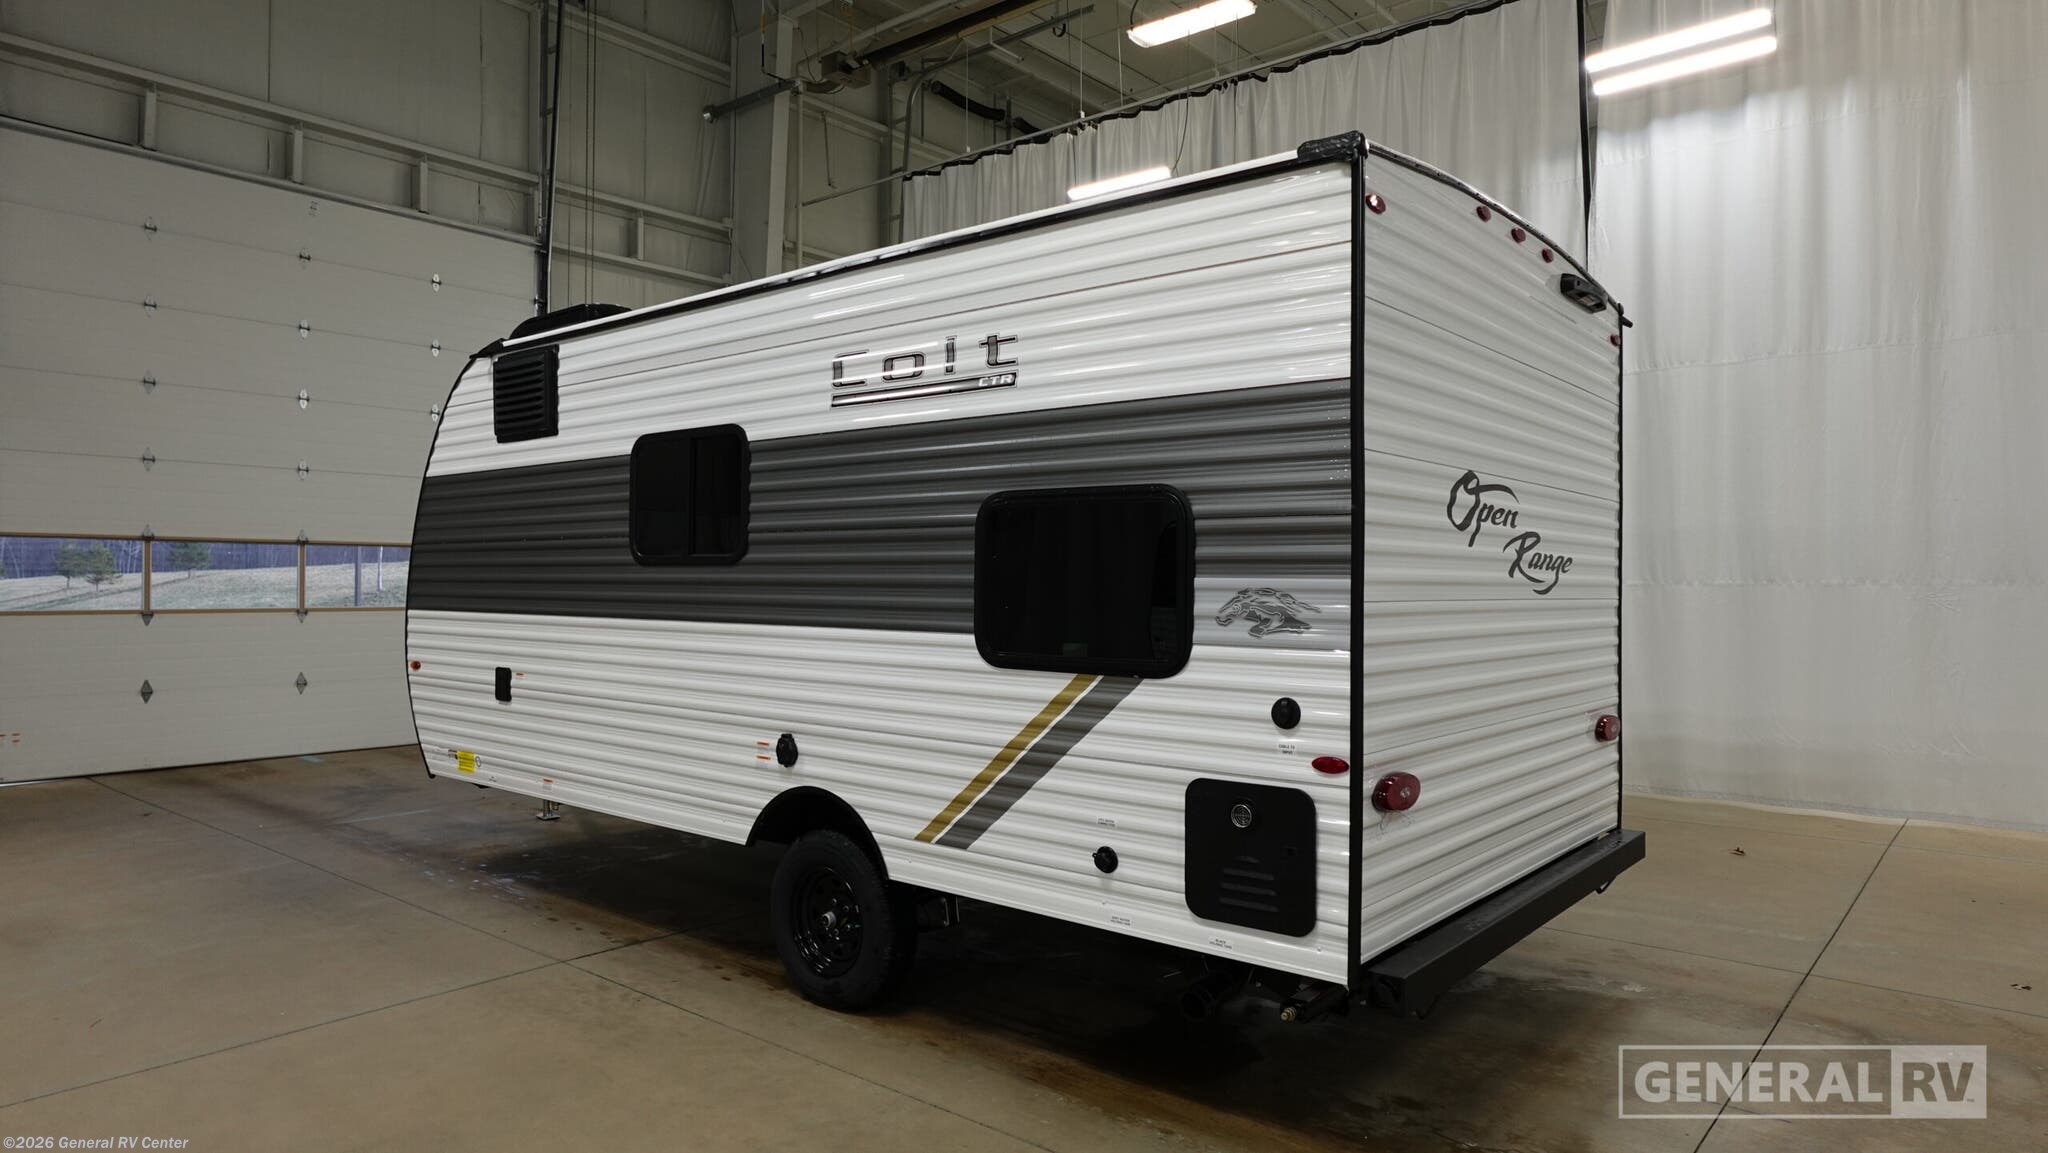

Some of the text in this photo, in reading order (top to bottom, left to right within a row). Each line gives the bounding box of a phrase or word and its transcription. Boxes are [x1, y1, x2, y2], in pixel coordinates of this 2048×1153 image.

[832, 334, 1018, 387] Colt
[978, 373, 1014, 388] CTR
[1446, 470, 1520, 548] Open
[1502, 531, 1573, 595] Range
